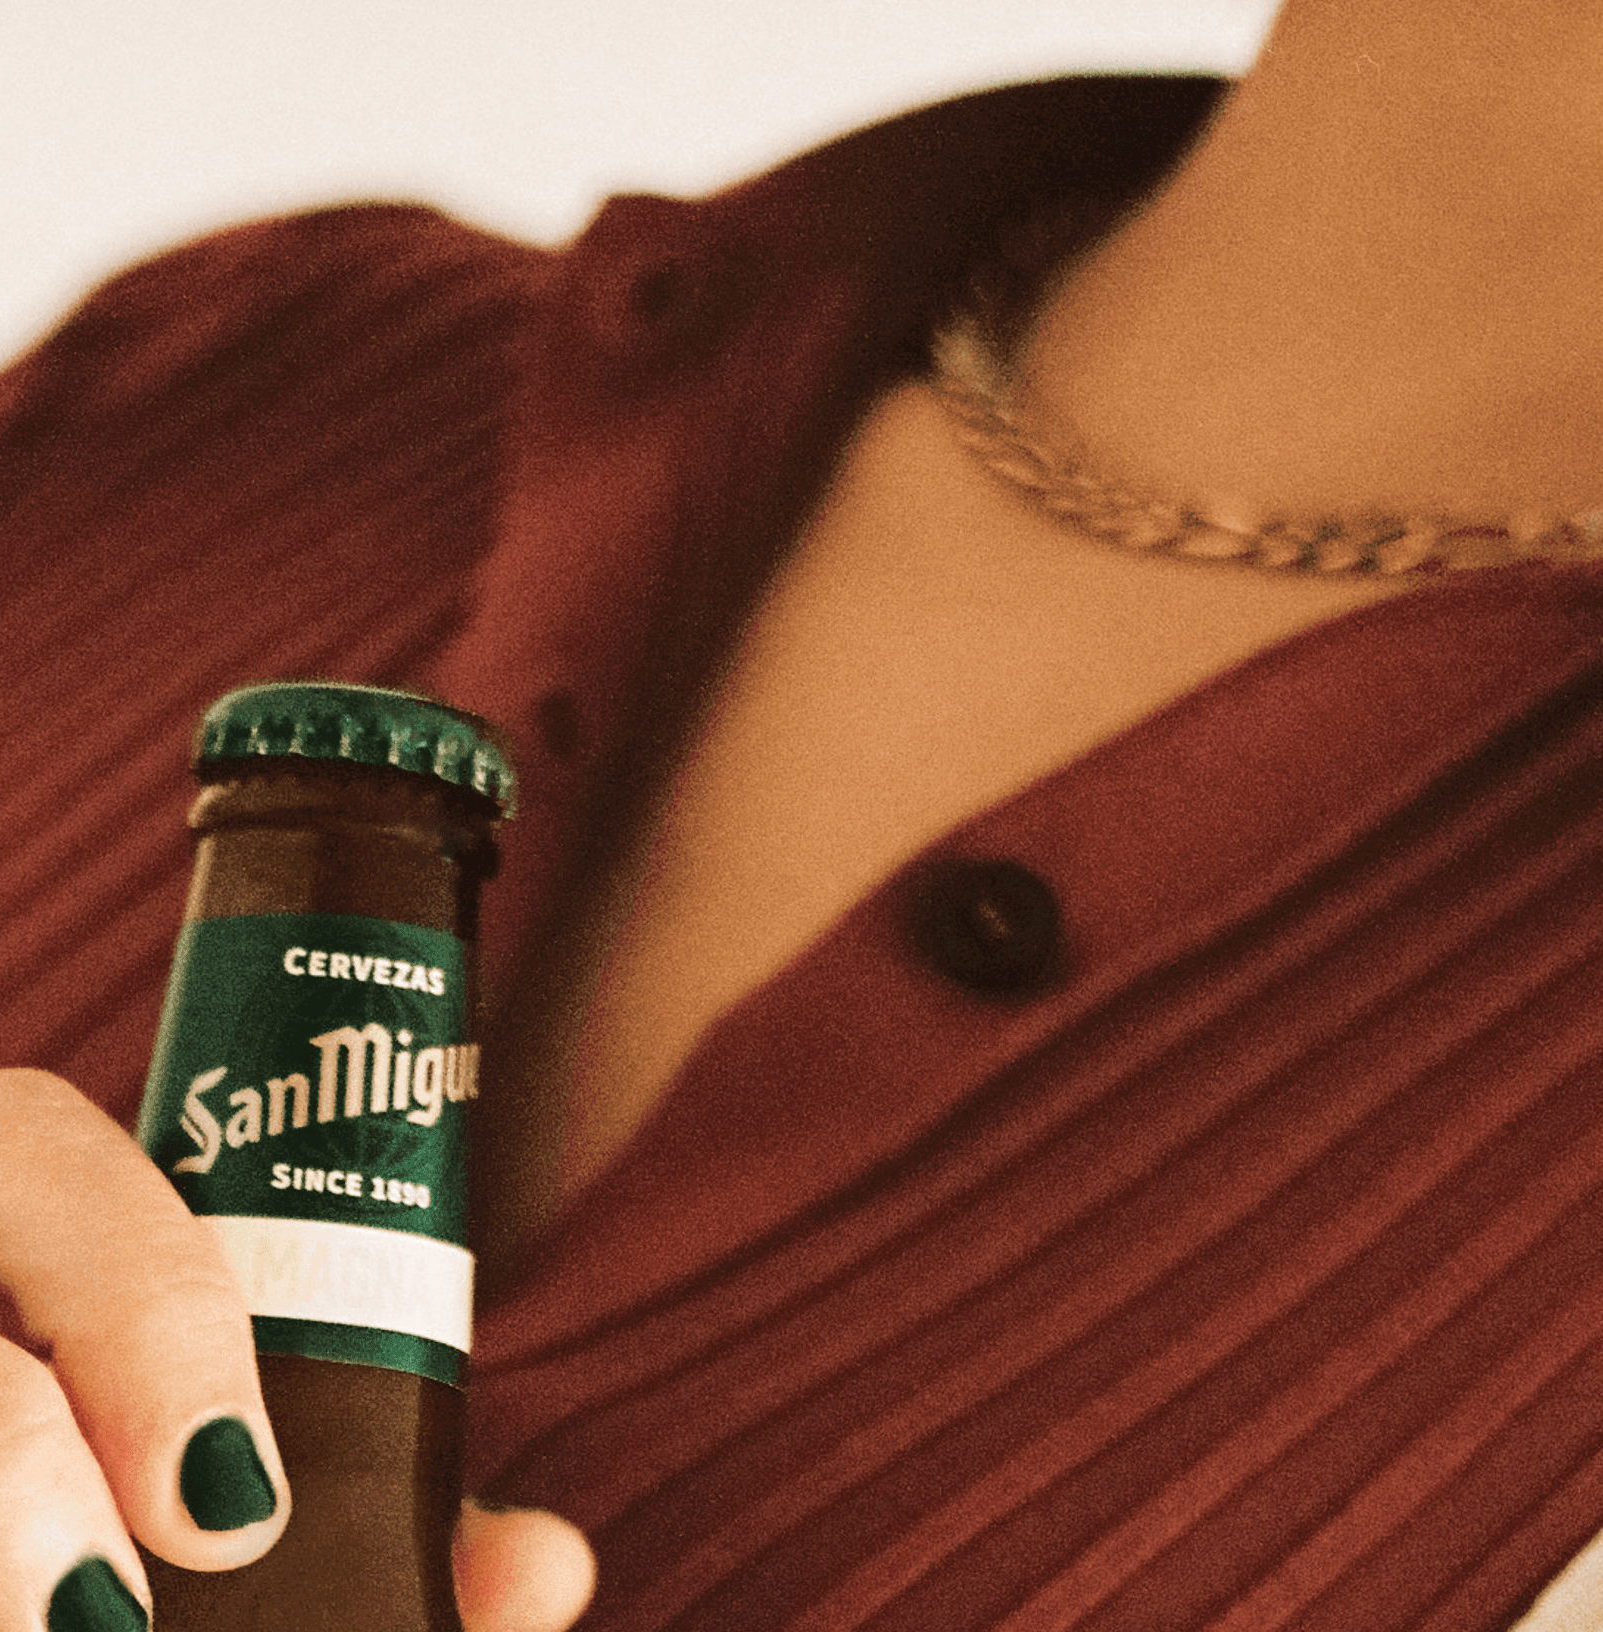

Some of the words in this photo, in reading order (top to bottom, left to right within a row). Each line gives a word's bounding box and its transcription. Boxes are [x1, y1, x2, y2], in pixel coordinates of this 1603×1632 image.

[282, 946, 447, 996] CERVEZAS
[173, 1022, 482, 1173] SanMigu
[270, 1162, 364, 1198] SINCE
